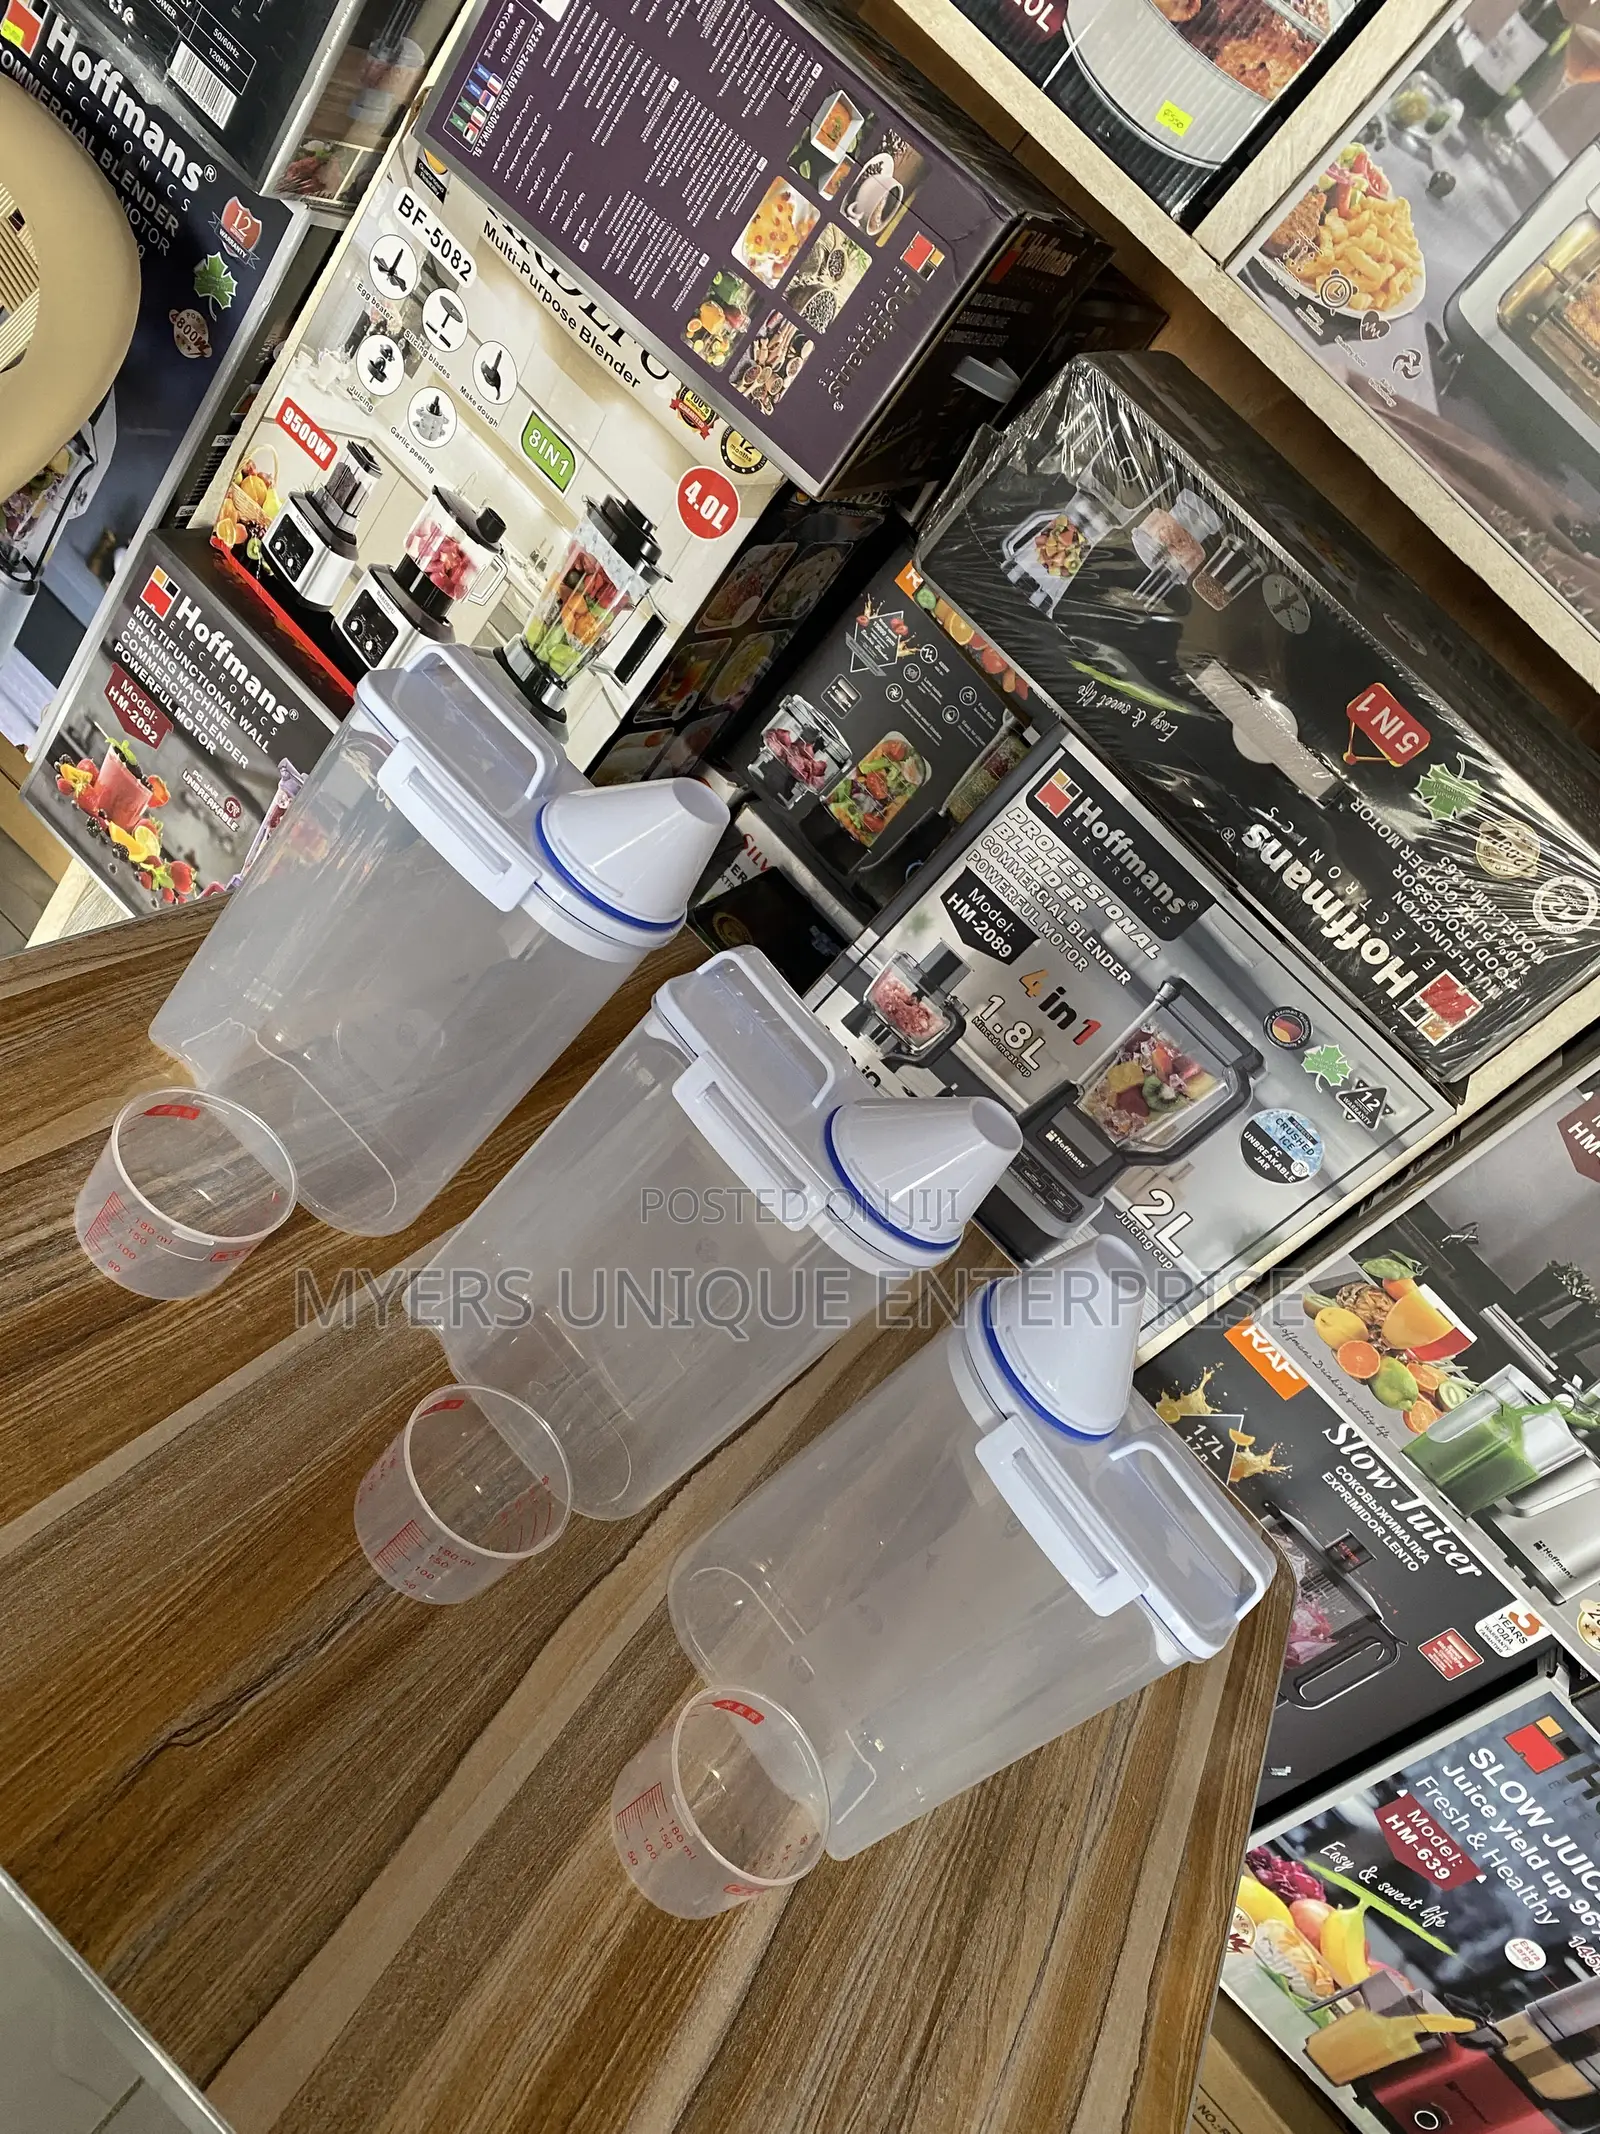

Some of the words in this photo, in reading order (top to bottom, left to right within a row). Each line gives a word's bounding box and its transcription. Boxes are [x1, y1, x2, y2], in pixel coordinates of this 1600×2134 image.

[505, 17, 525, 54] exported
[534, 20, 544, 35] AC
[208, 47, 232, 73] 1200W
[500, 52, 508, 65] to
[100, 150, 180, 238] BLENDER
[218, 227, 248, 260] WARRANTY
[232, 207, 254, 238] 12
[396, 194, 475, 283] BF-5082
[356, 283, 372, 302] Egg
[370, 295, 396, 322] beater
[483, 219, 578, 331] Multi-Purpose
[578, 322, 642, 390] Blender
[403, 329, 429, 361] Slicing
[426, 353, 452, 380] blades
[349, 384, 375, 413] Juicing
[459, 385, 475, 406] Make
[474, 401, 500, 429] dough
[282, 405, 332, 464] 9500W
[389, 425, 412, 451] Garlic
[409, 446, 436, 475] peeling
[684, 479, 730, 533] 4.0L
[125, 617, 180, 675] BRAKING
[176, 669, 230, 729] MACHINE
[133, 604, 236, 722] MULTIFUNCTIONAL
[238, 717, 271, 754] WALL
[169, 619, 279, 737] ELECTRONICS
[1075, 680, 1098, 707] life
[107, 685, 159, 745] HM-2092
[113, 640, 176, 714] POWERFUL
[173, 706, 217, 756] MOTOR
[120, 630, 196, 714] COMMERCIAL
[193, 706, 250, 770] BLENDER
[120, 677, 160, 725] Model:
[1095, 694, 1132, 715] sweet
[1131, 707, 1147, 728] &
[1355, 691, 1378, 713] 1
[1150, 710, 1179, 743] Easy
[1369, 706, 1404, 739] IN
[1398, 730, 1420, 755] 5
[181, 771, 240, 832] UNBREAKABLE
[191, 768, 204, 783] PC
[203, 780, 219, 799] JAR
[1350, 797, 1412, 850] MOTOR
[992, 821, 1088, 915] BLENDER
[1006, 806, 1162, 962] PROFESSIONAL
[1062, 816, 1171, 925] ELECTRONICS
[1265, 805, 1435, 972] ELECTRONICS
[1399, 844, 1459, 904] COPPER
[946, 890, 1013, 960] HM-2089
[966, 848, 1038, 927] POWERFUL
[1038, 919, 1090, 973] MOTOR
[967, 887, 1017, 939] Model:
[980, 834, 1067, 926] COMMERCIAL
[1065, 917, 1133, 988] BLENDER
[1391, 866, 1479, 951] PROCESSOR
[1457, 900, 1498, 944] PURE
[1390, 890, 1505, 1002] MULTI-FUNCTION
[1474, 945, 1518, 990] FOOD
[1018, 968, 1049, 999] 4
[1037, 986, 1078, 1031] in
[1074, 1018, 1103, 1047] 1
[971, 1015, 1001, 1047] Minced
[996, 1042, 1019, 1065] meat
[1014, 1059, 1032, 1078] cup
[979, 993, 1046, 1071] 1.8L
[1342, 1096, 1372, 1126] WARRANTY
[1360, 1091, 1381, 1112] 12
[1242, 1130, 1296, 1184] UNBREAKABLE
[1270, 1144, 1283, 1158] PC
[1274, 1116, 1315, 1157] CRUSHED
[1278, 1133, 1296, 1154] ICE
[1254, 1154, 1271, 1172] JAR
[127, 1227, 148, 1246] 150
[134, 1217, 156, 1236] 180
[157, 1233, 174, 1246] ml
[1114, 1209, 1157, 1256] Juicing
[1150, 1243, 1177, 1271] cup
[1128, 1188, 1195, 1259] 2L
[107, 1259, 122, 1274] 50
[116, 1241, 137, 1261] 100
[1240, 1322, 1301, 1381] RAF
[1346, 1395, 1376, 1426] quality
[1193, 1424, 1225, 1461] 1.7L
[1320, 1471, 1386, 1541] EXPRIMIDOR
[1381, 1535, 1420, 1574] LENTO
[1322, 1422, 1399, 1491] Slow
[1390, 1493, 1484, 1580] Juicer
[1334, 1464, 1432, 1566] СОКОВЫЖИМАЛКА
[413, 1565, 435, 1581] 100
[427, 1553, 449, 1569] 150
[437, 1545, 459, 1563] 180
[402, 1578, 417, 1590] 50
[1483, 1625, 1510, 1652] WARRANTY
[1492, 1623, 1514, 1646] ГОДА
[1497, 1613, 1529, 1645] YEARS
[1467, 1746, 1556, 1829] SLOW
[642, 1837, 658, 1861] 100
[658, 1826, 674, 1850] 150
[668, 1818, 685, 1844] 180
[682, 1846, 698, 1861] ml
[1383, 1812, 1452, 1882] HM-639
[1405, 1808, 1463, 1869] Model:
[1415, 1774, 1471, 1833] Fresh
[1465, 1831, 1489, 1853] &
[1480, 1846, 1561, 1928] Healthy
[1442, 1763, 1498, 1817] Juice
[1487, 1817, 1551, 1872] yield
[1540, 1869, 1573, 1900] up
[627, 1850, 639, 1867] 50
[1319, 1840, 1356, 1874] Easy
[1357, 1865, 1379, 1886] &
[1376, 1880, 1425, 1914] sweet
[1419, 1902, 1449, 1929] life
[1511, 1942, 1536, 1967] Large
[1518, 1940, 1541, 1963] Extra
